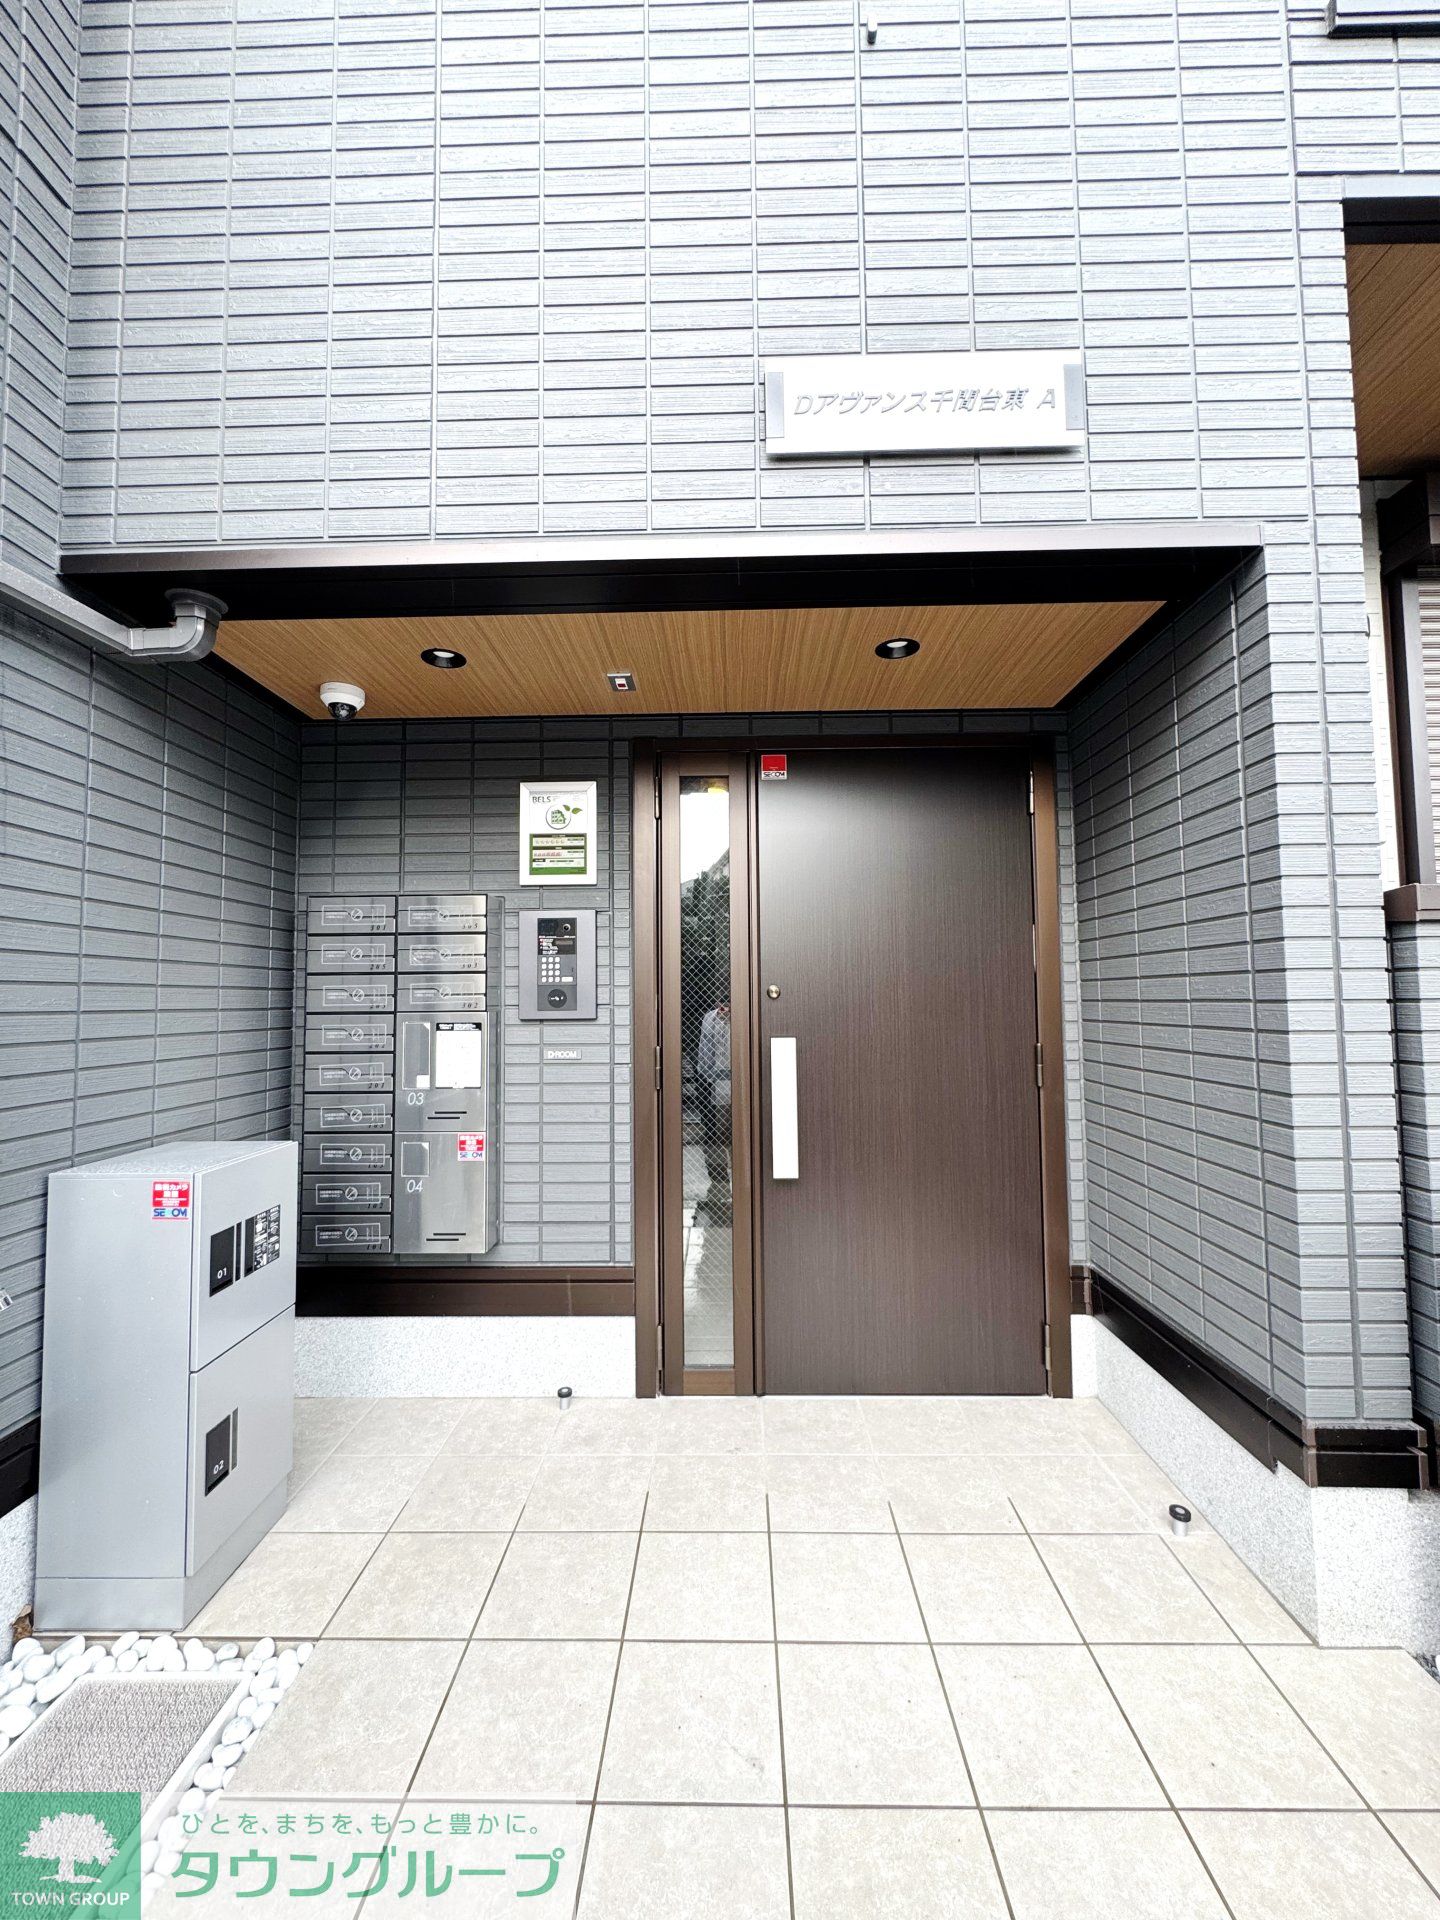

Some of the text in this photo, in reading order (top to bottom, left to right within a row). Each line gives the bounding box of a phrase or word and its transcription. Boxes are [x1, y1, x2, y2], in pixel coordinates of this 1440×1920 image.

[1036, 388, 1056, 409] A
[407, 1092, 424, 1105] 03
[406, 1179, 424, 1193] 04
[217, 1267, 227, 1279] 01
[213, 1460, 225, 1475] 02
